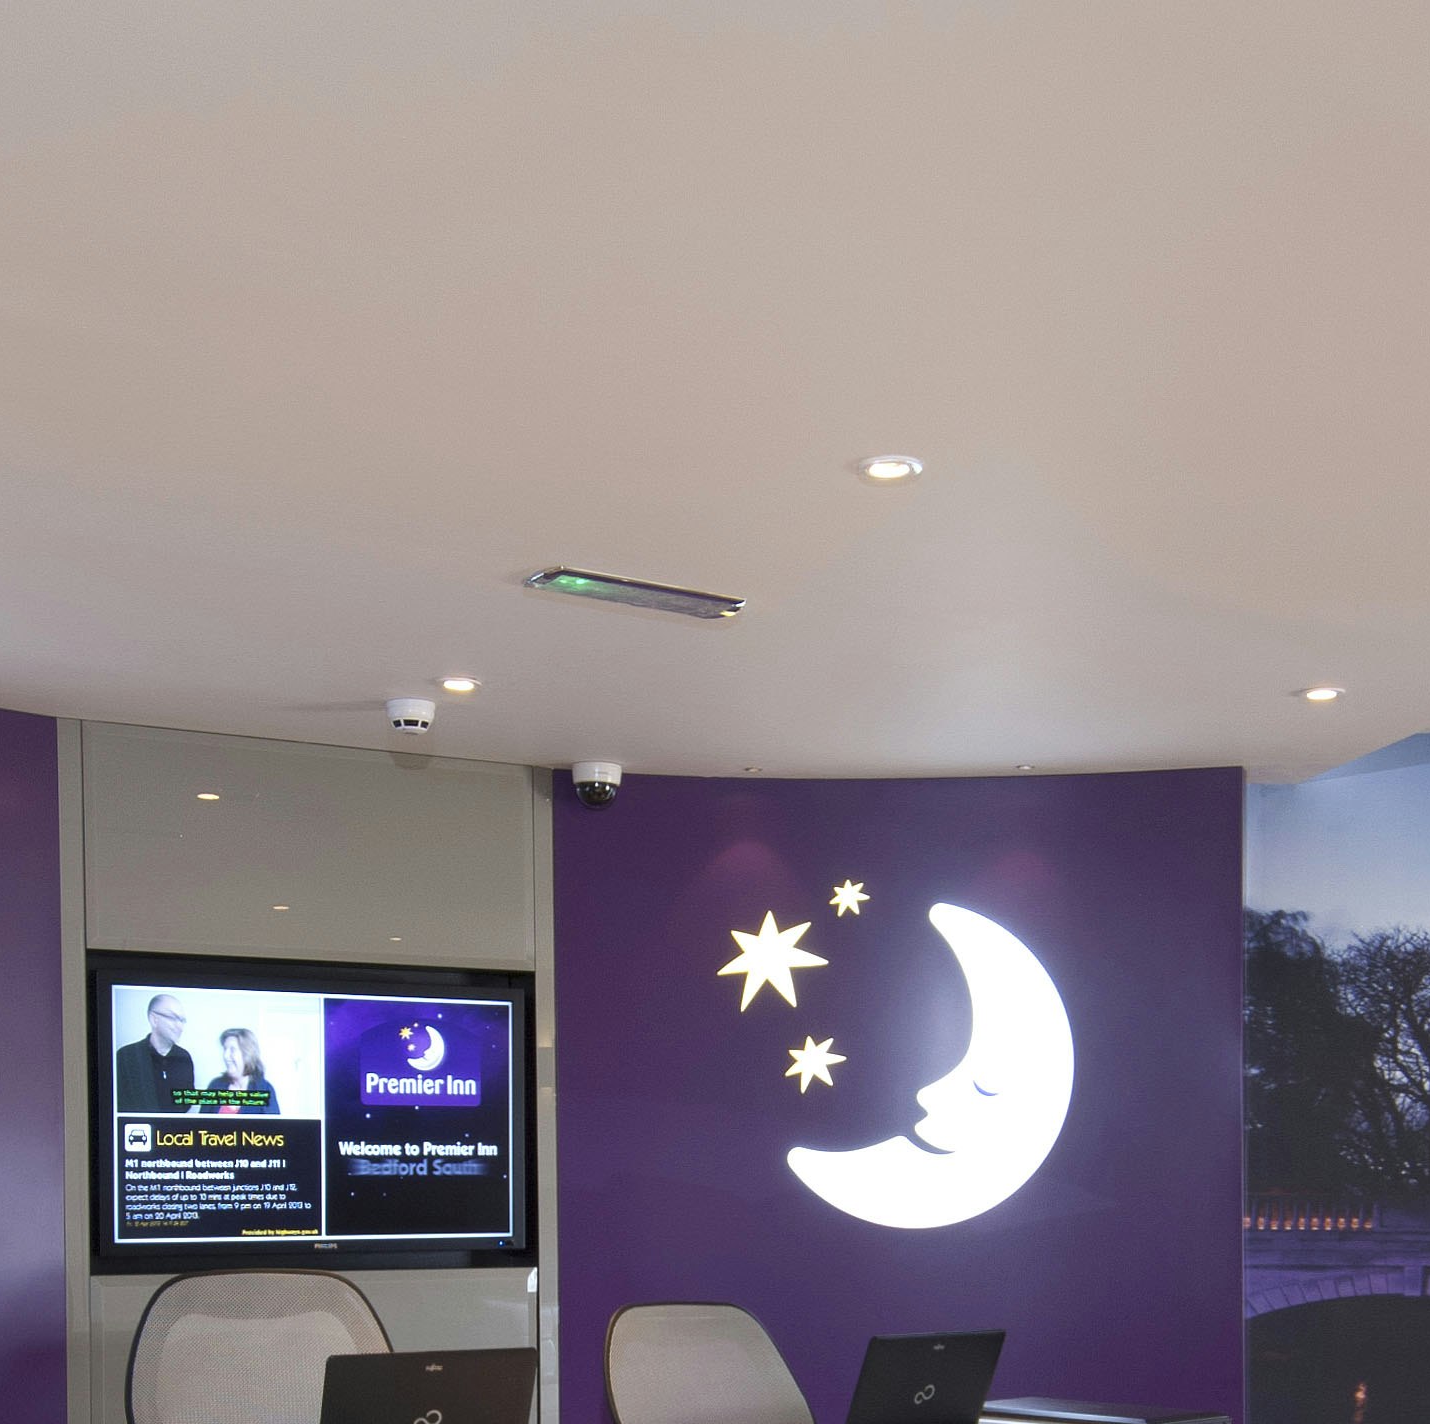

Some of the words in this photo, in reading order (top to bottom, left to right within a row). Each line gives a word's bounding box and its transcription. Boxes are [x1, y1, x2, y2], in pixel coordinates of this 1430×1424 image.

[366, 1073, 444, 1095] Premier
[447, 1074, 476, 1095] Inn
[156, 1130, 193, 1146] Local
[198, 1130, 237, 1147] Travel
[242, 1131, 284, 1147] News
[338, 1141, 402, 1156] Welcome
[404, 1142, 420, 1156] to
[423, 1141, 474, 1156] Premier
[477, 1142, 498, 1156] Inn
[359, 1158, 428, 1176] Bedford
